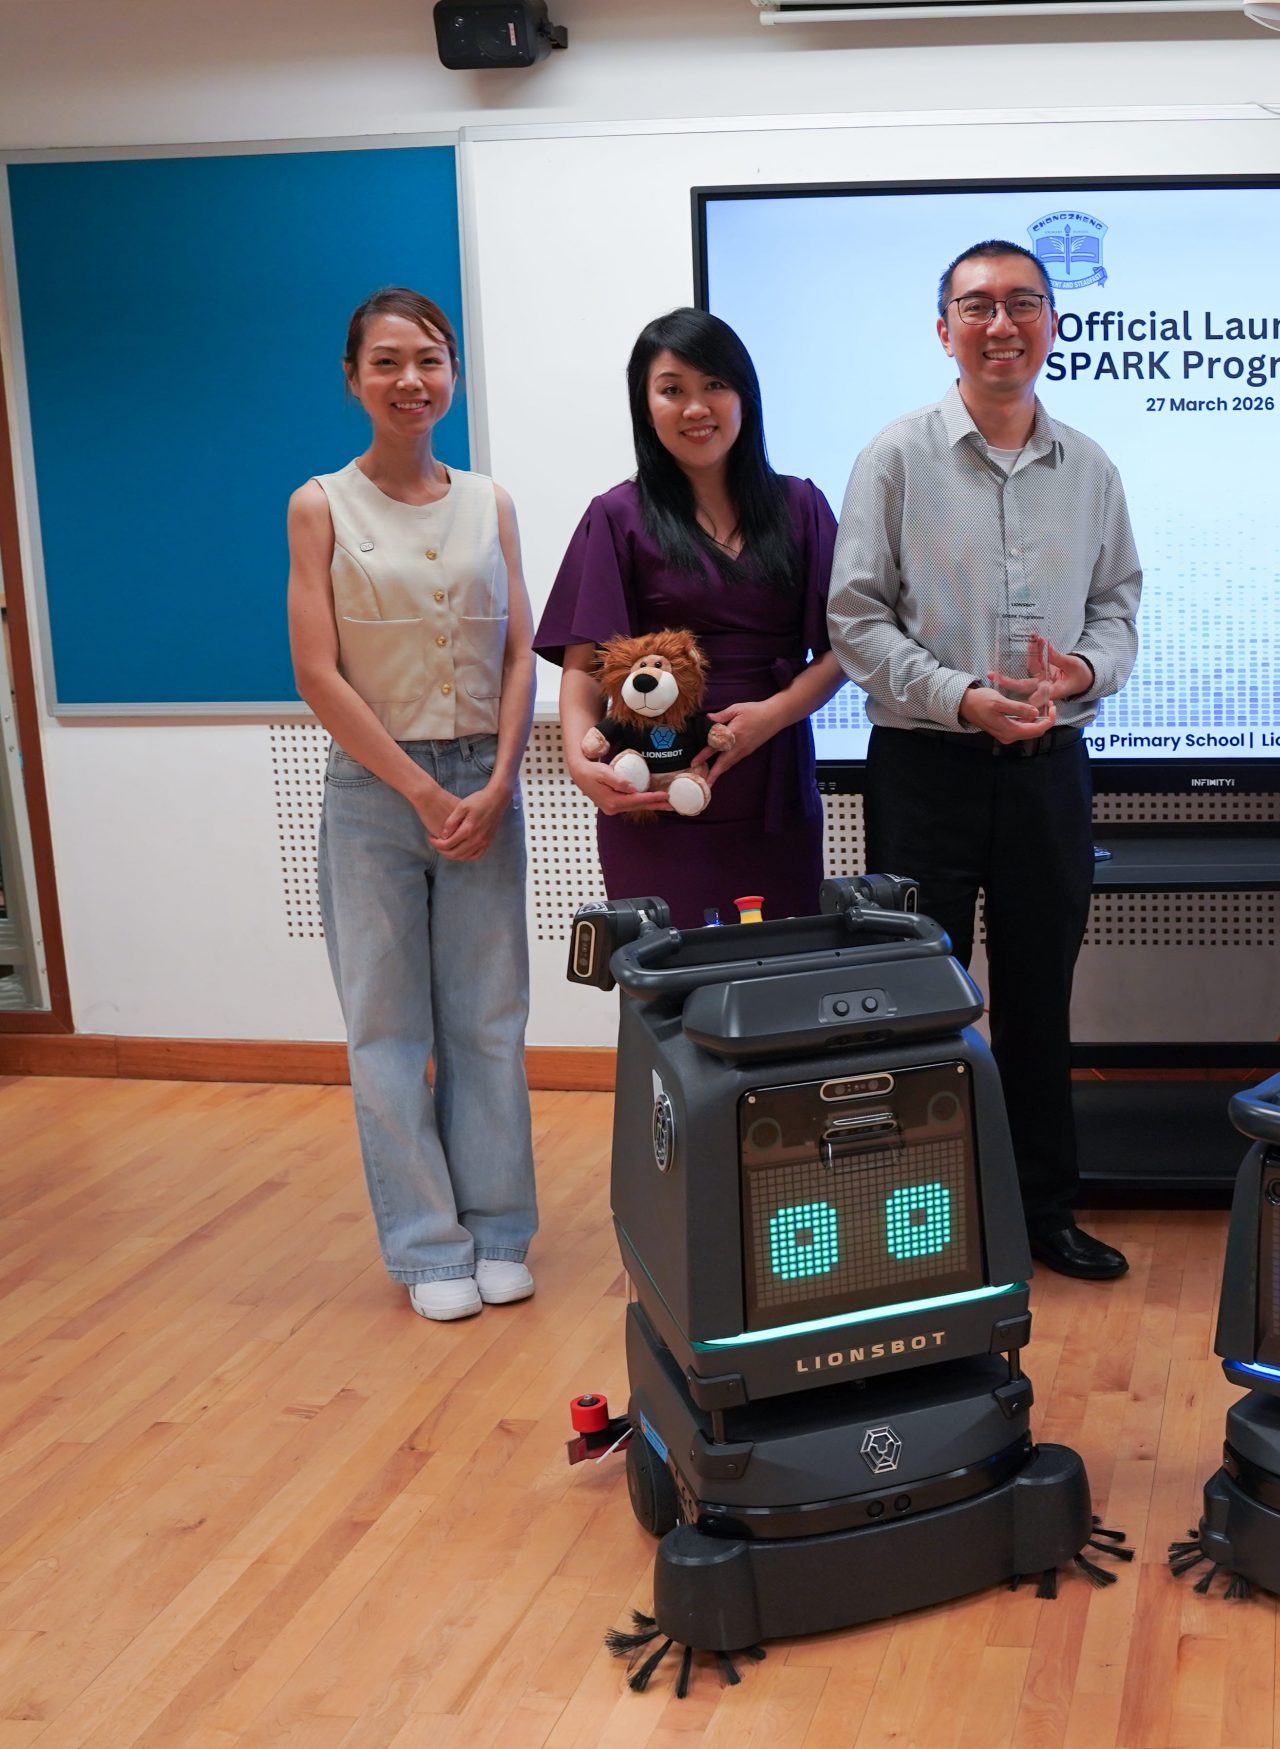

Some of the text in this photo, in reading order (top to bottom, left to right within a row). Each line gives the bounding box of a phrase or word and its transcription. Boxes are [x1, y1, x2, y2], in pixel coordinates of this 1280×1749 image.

[1057, 310, 1193, 342] Official
[1045, 351, 1171, 381] SPARK
[1146, 396, 1275, 412] 27 March 2026
[642, 749, 683, 758] LIONSBOT
[1110, 732, 1181, 752] Primary
[1185, 733, 1245, 747] School
[796, 1331, 946, 1373] LIONSBOT
